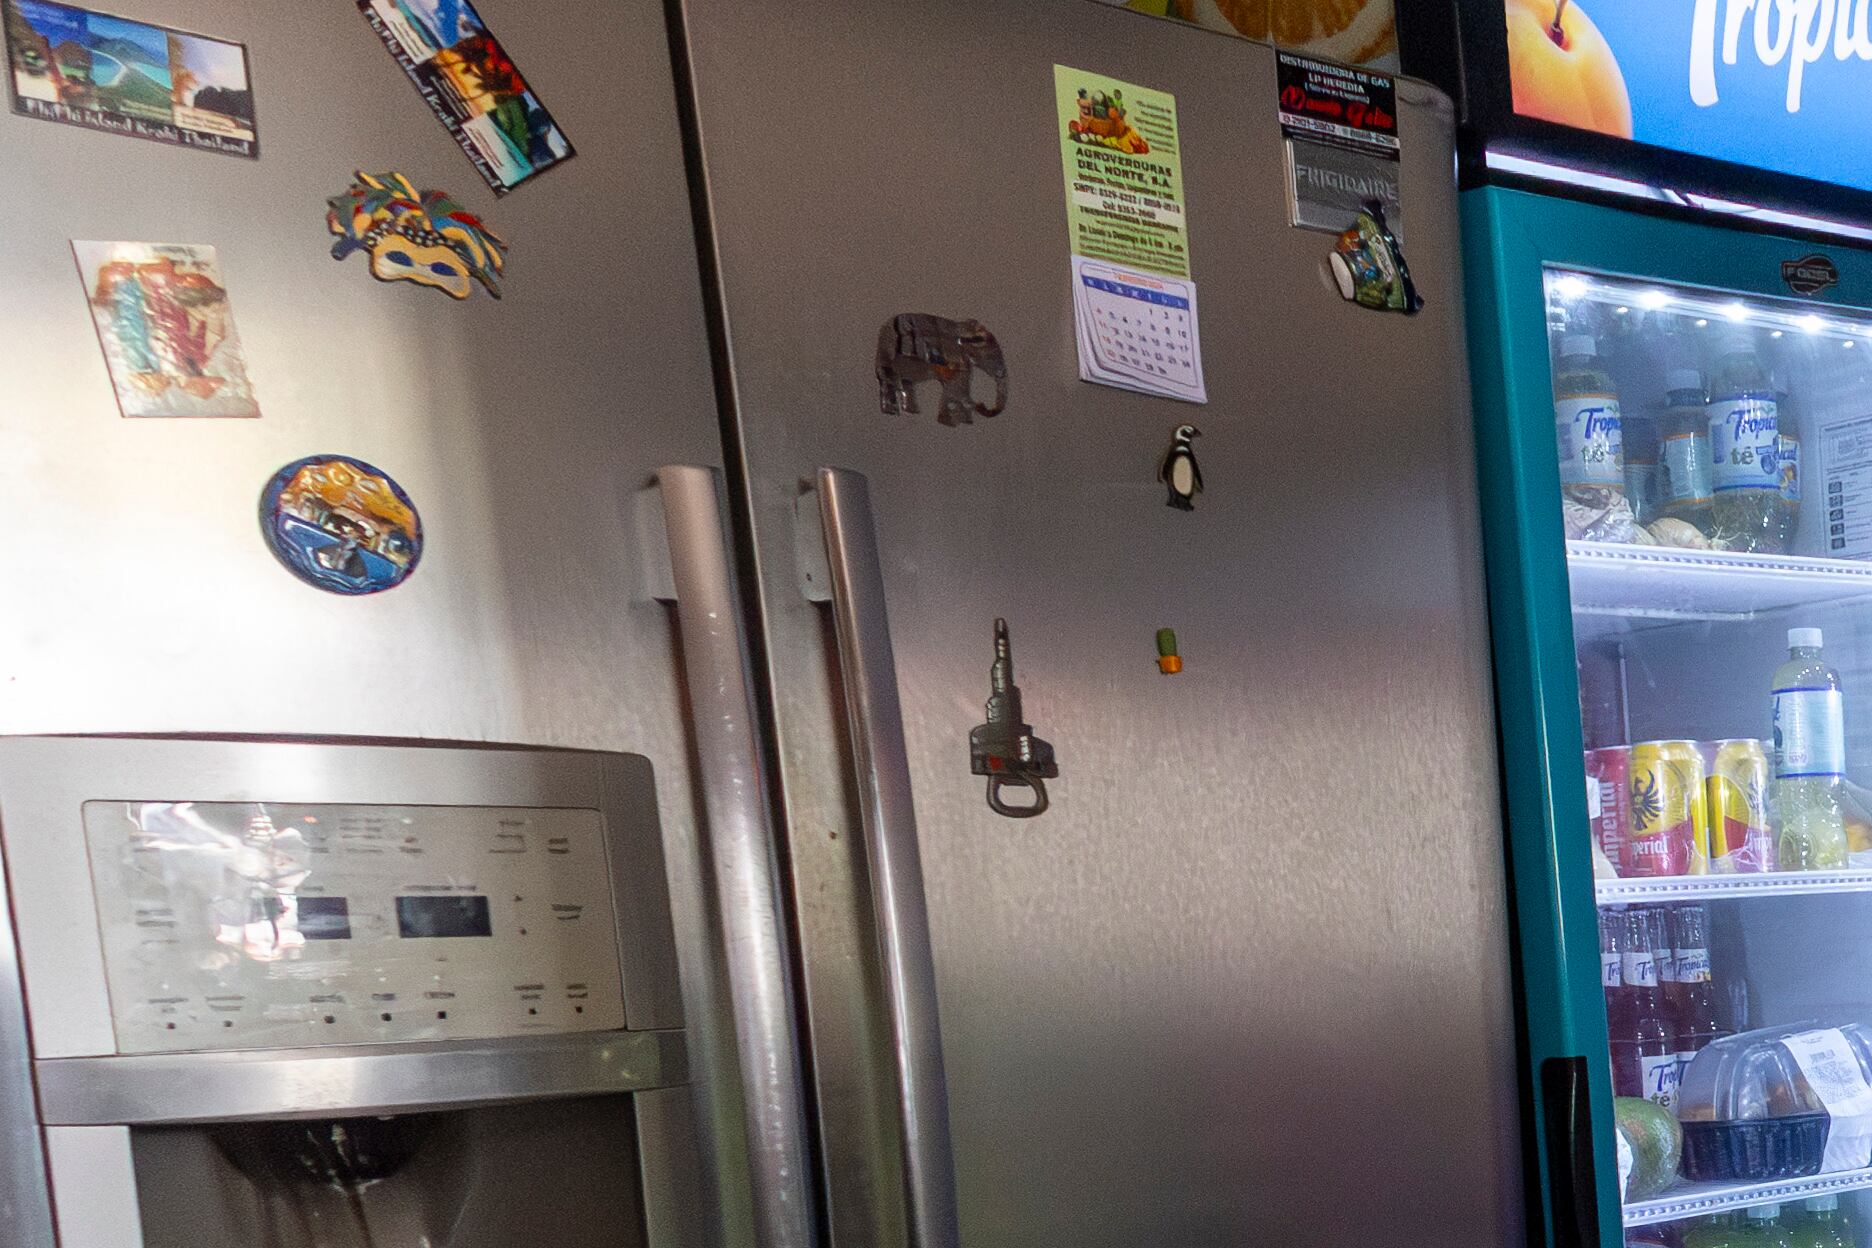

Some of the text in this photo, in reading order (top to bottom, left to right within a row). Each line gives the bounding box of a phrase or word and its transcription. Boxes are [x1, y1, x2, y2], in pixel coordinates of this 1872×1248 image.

[1371, 76, 1390, 88] GAS
[1076, 147, 1172, 177] AGROVERDURAS
[1078, 159, 1102, 173] DEL
[1296, 164, 1398, 200] FRIGIDAIRE
